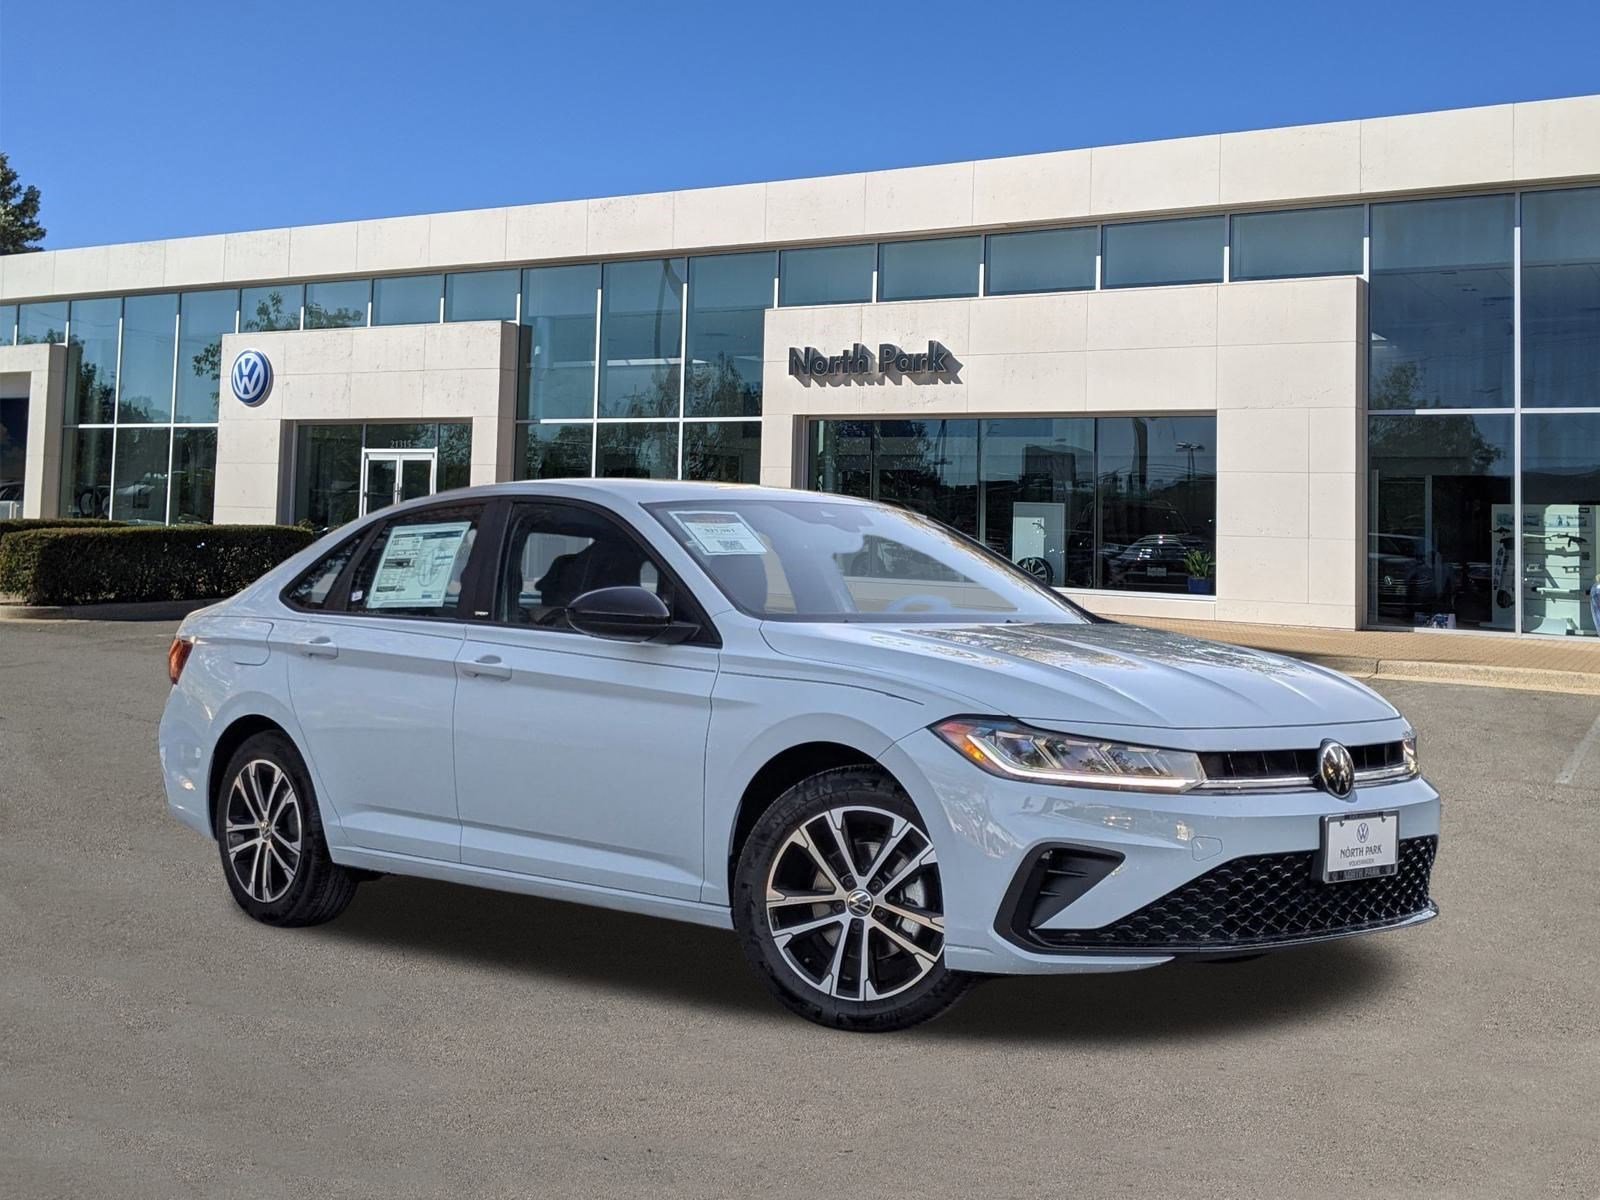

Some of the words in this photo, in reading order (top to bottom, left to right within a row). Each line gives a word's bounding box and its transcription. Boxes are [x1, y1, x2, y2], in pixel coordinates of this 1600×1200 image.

[231, 350, 269, 403] VW
[789, 342, 871, 377] North
[878, 340, 949, 375] Park
[1340, 846, 1364, 859] NORTH
[1365, 844, 1383, 857] PARK
